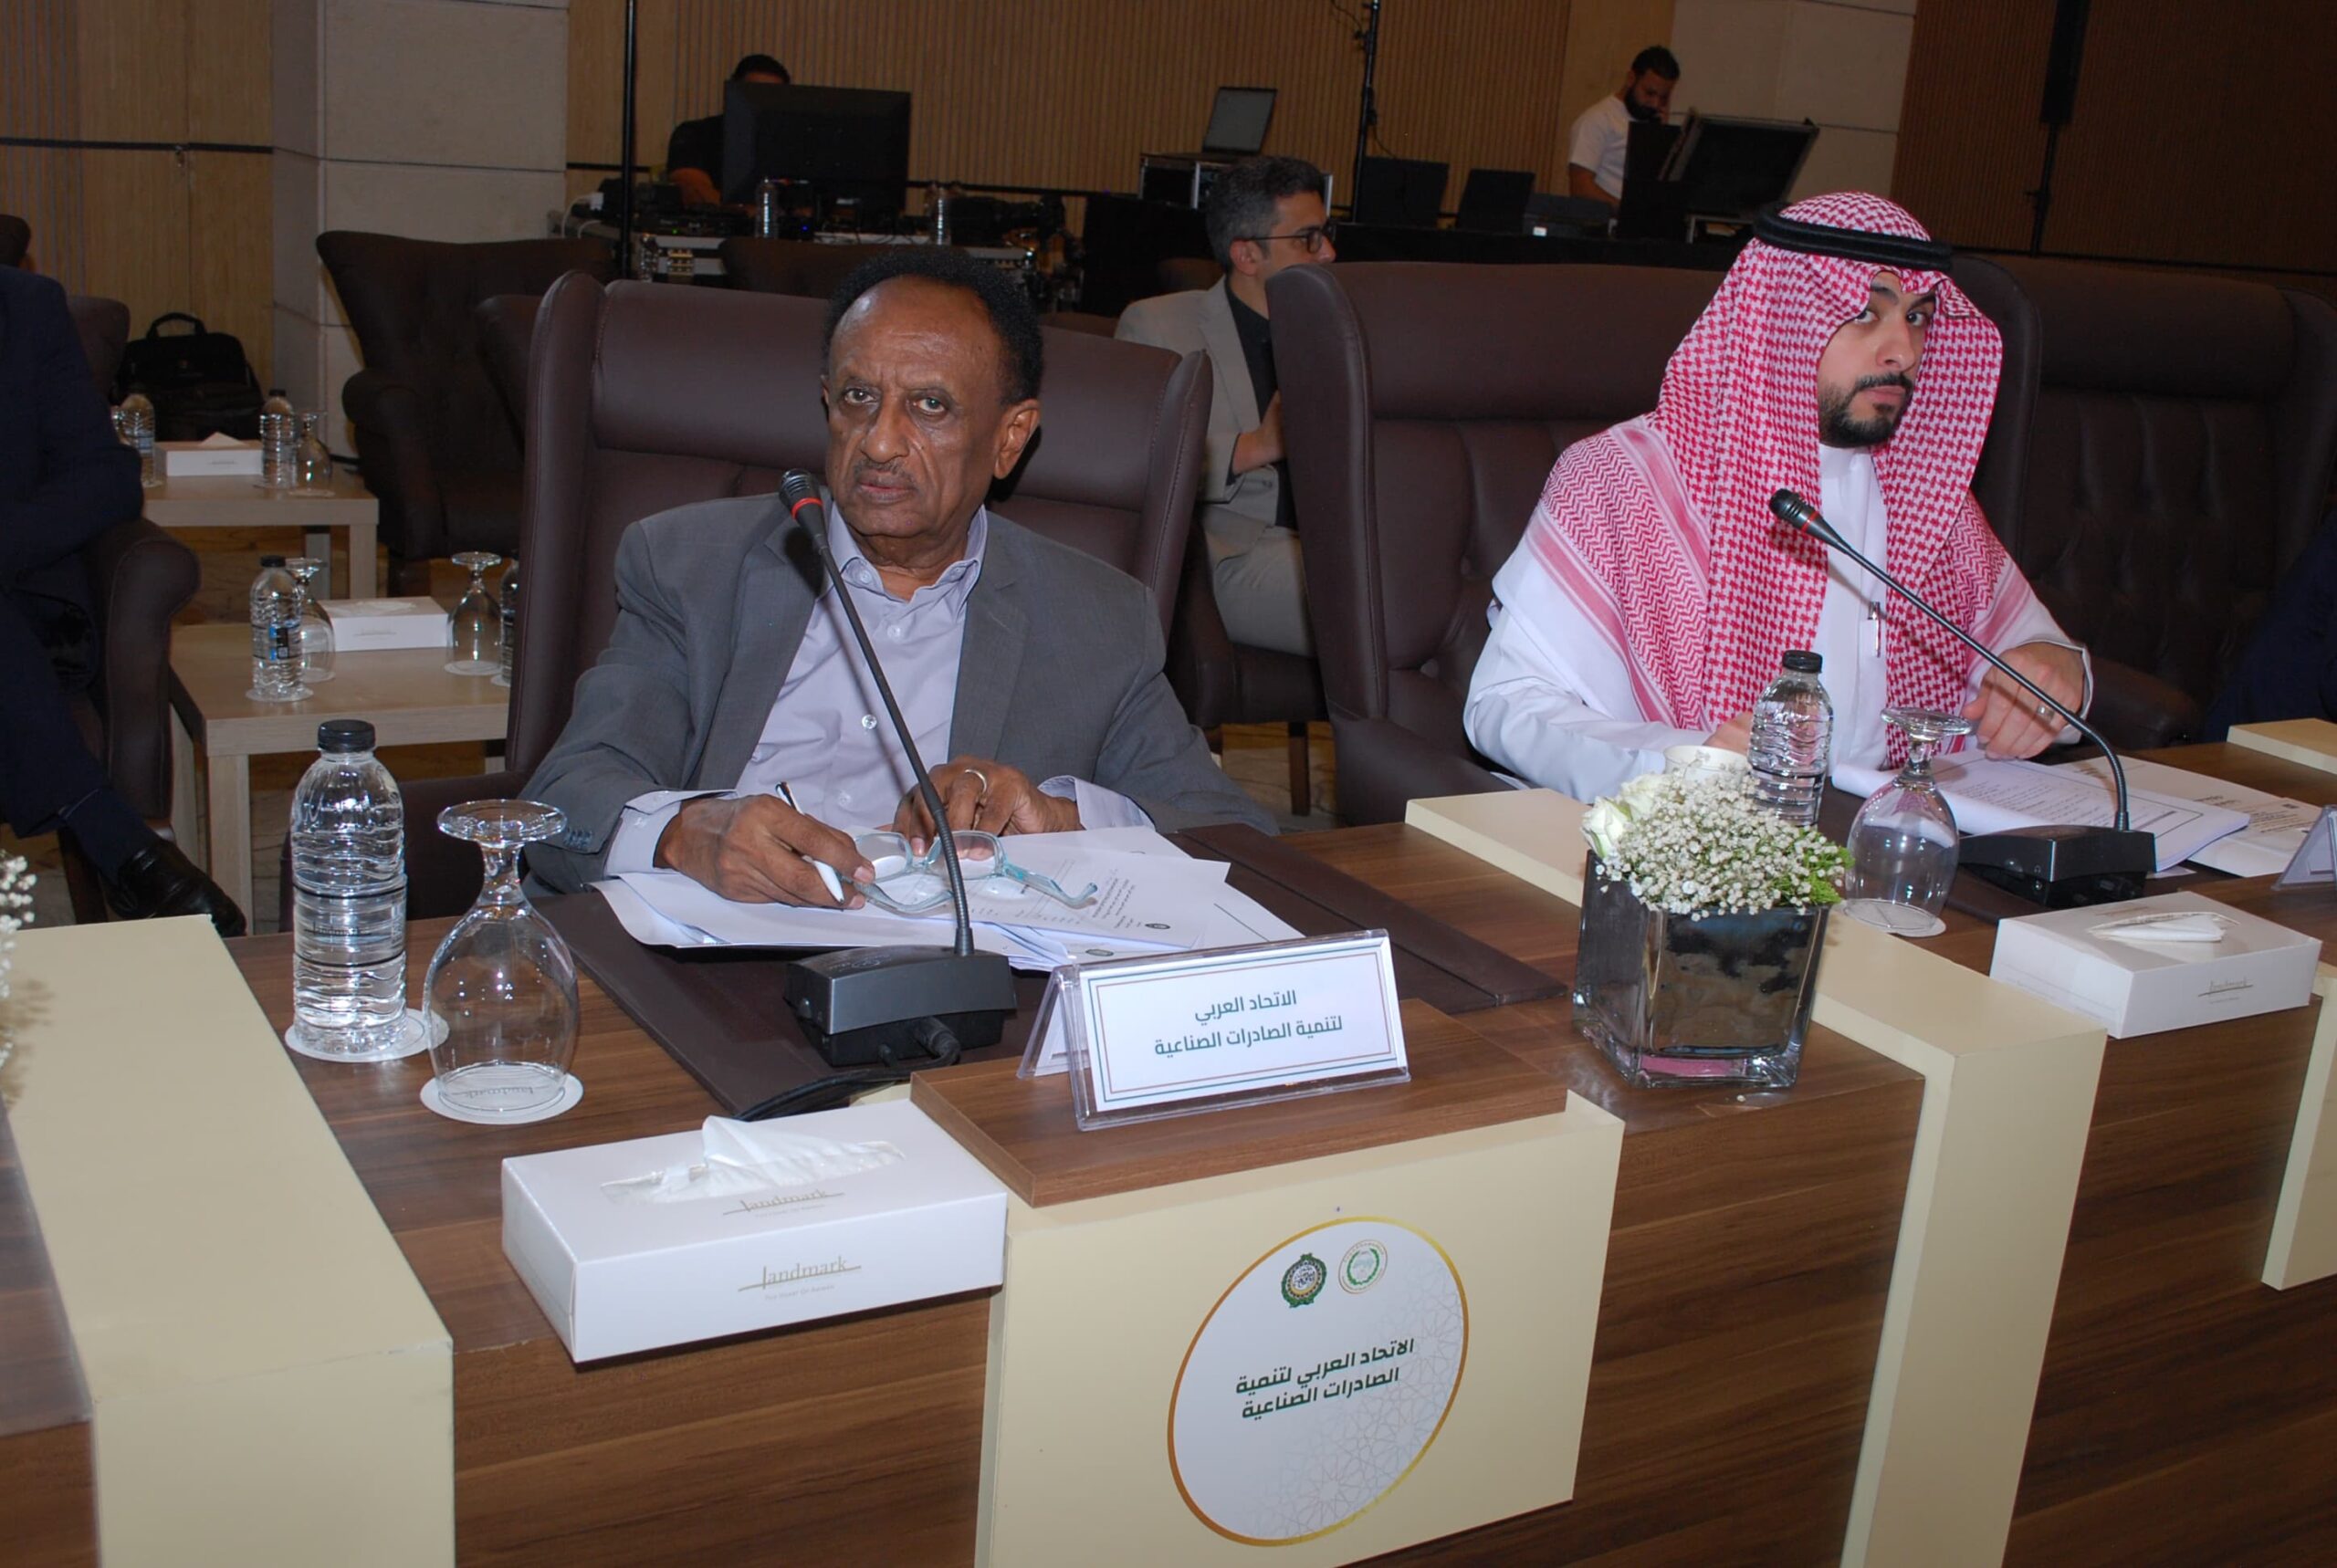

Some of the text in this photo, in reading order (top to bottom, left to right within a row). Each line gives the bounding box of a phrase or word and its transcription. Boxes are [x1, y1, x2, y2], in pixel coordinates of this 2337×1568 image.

[1194, 989, 1297, 1026] الاتحاد العربي
[1155, 1015, 1343, 1059] لتنمية الصادرات الصناعية
[761, 1255, 848, 1291] landmark
[1235, 1338, 1415, 1397] الاتحاد العربي لتنمية
[1242, 1367, 1399, 1421] الصادرات الصناعية
